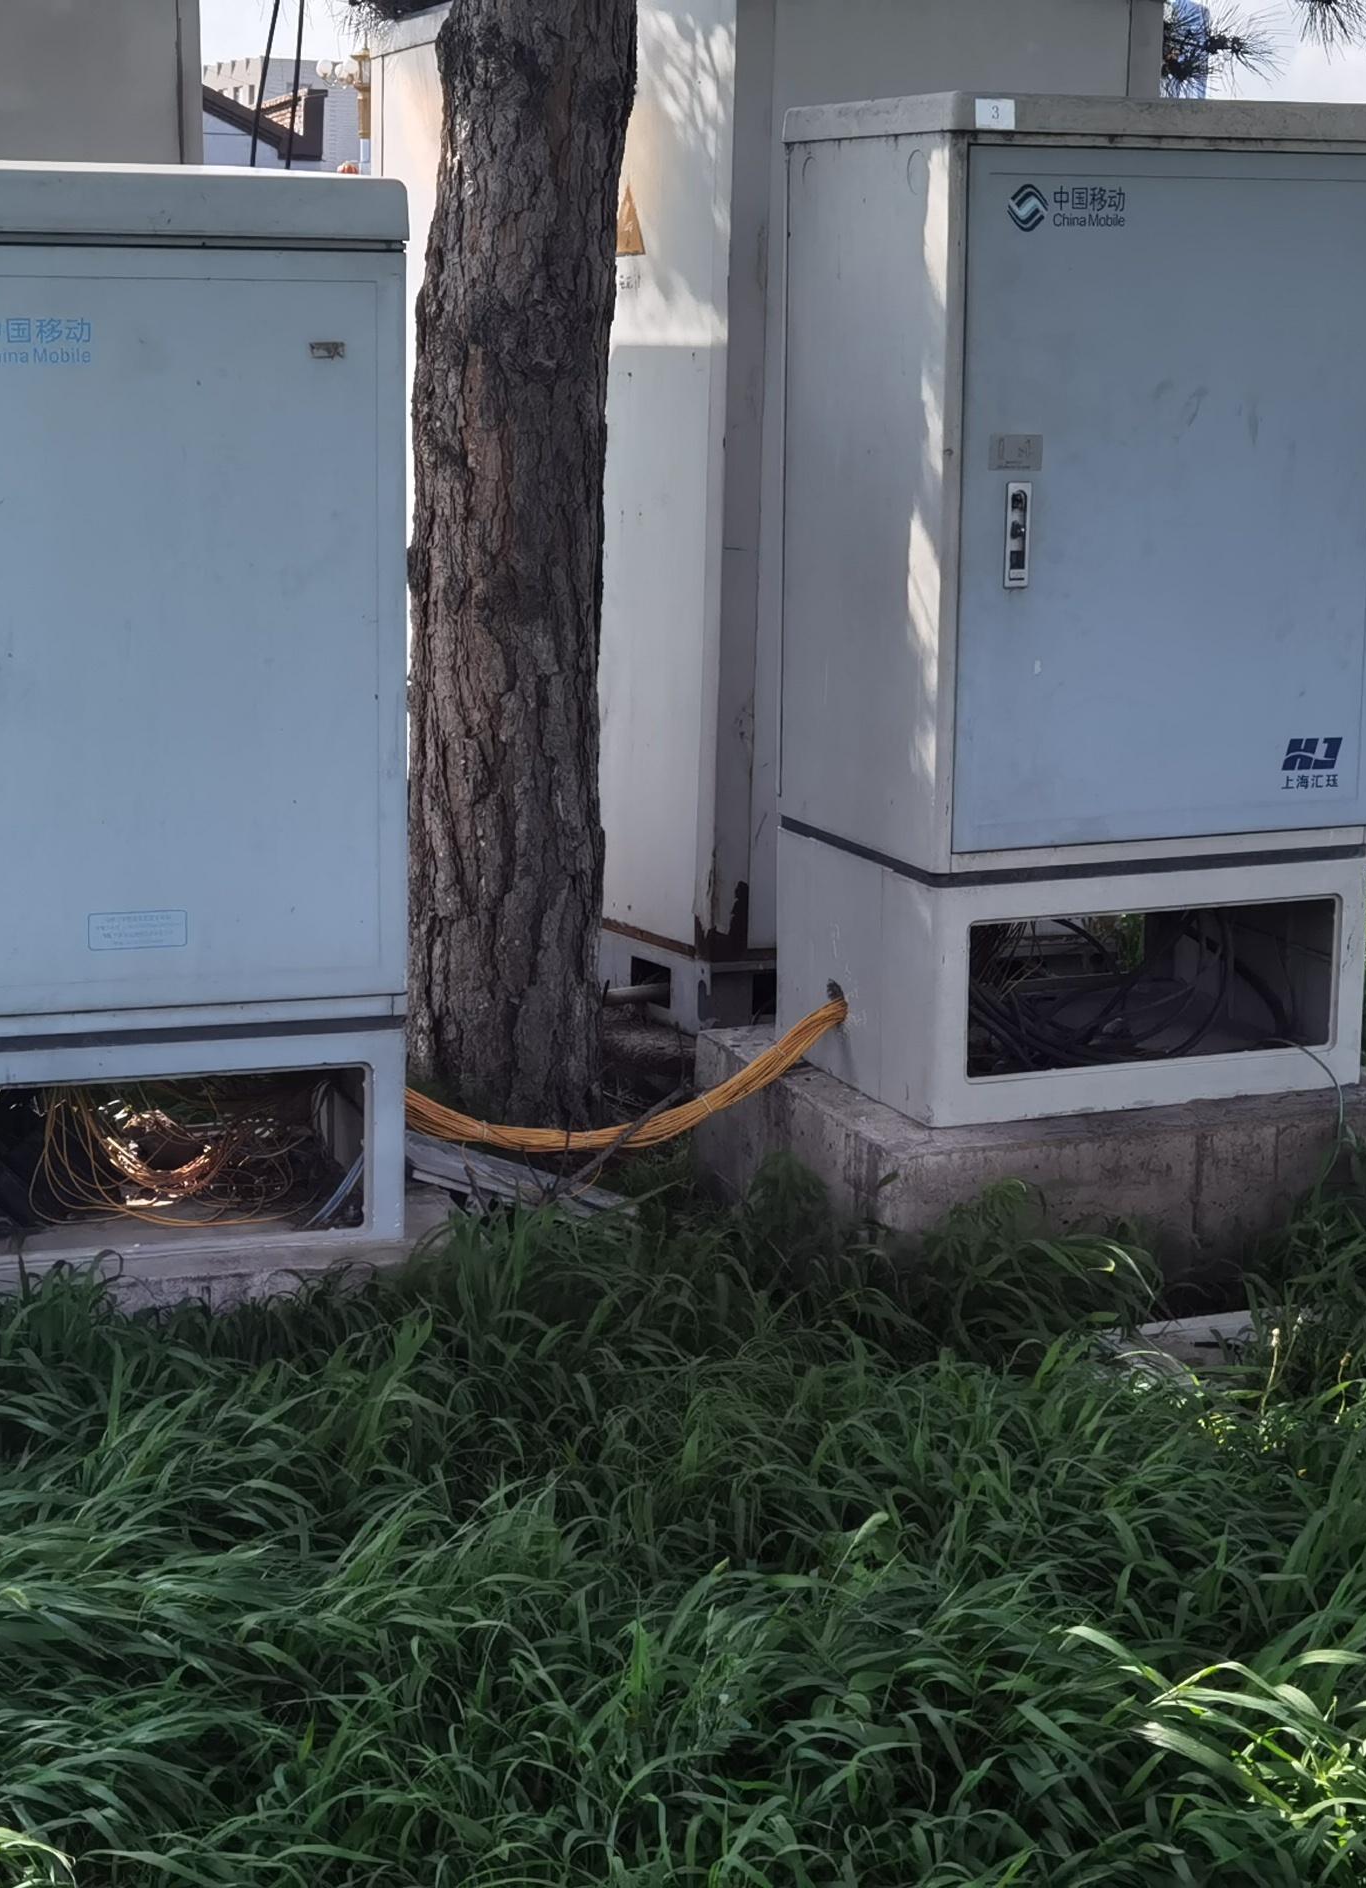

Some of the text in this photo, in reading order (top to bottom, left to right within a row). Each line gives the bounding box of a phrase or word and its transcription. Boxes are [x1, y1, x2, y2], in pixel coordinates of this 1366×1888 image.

[991, 105, 1000, 120] 3
[1053, 185, 1126, 212] 中国移动
[1052, 213, 1126, 228] China Mobile
[33, 347, 92, 364] Mobile
